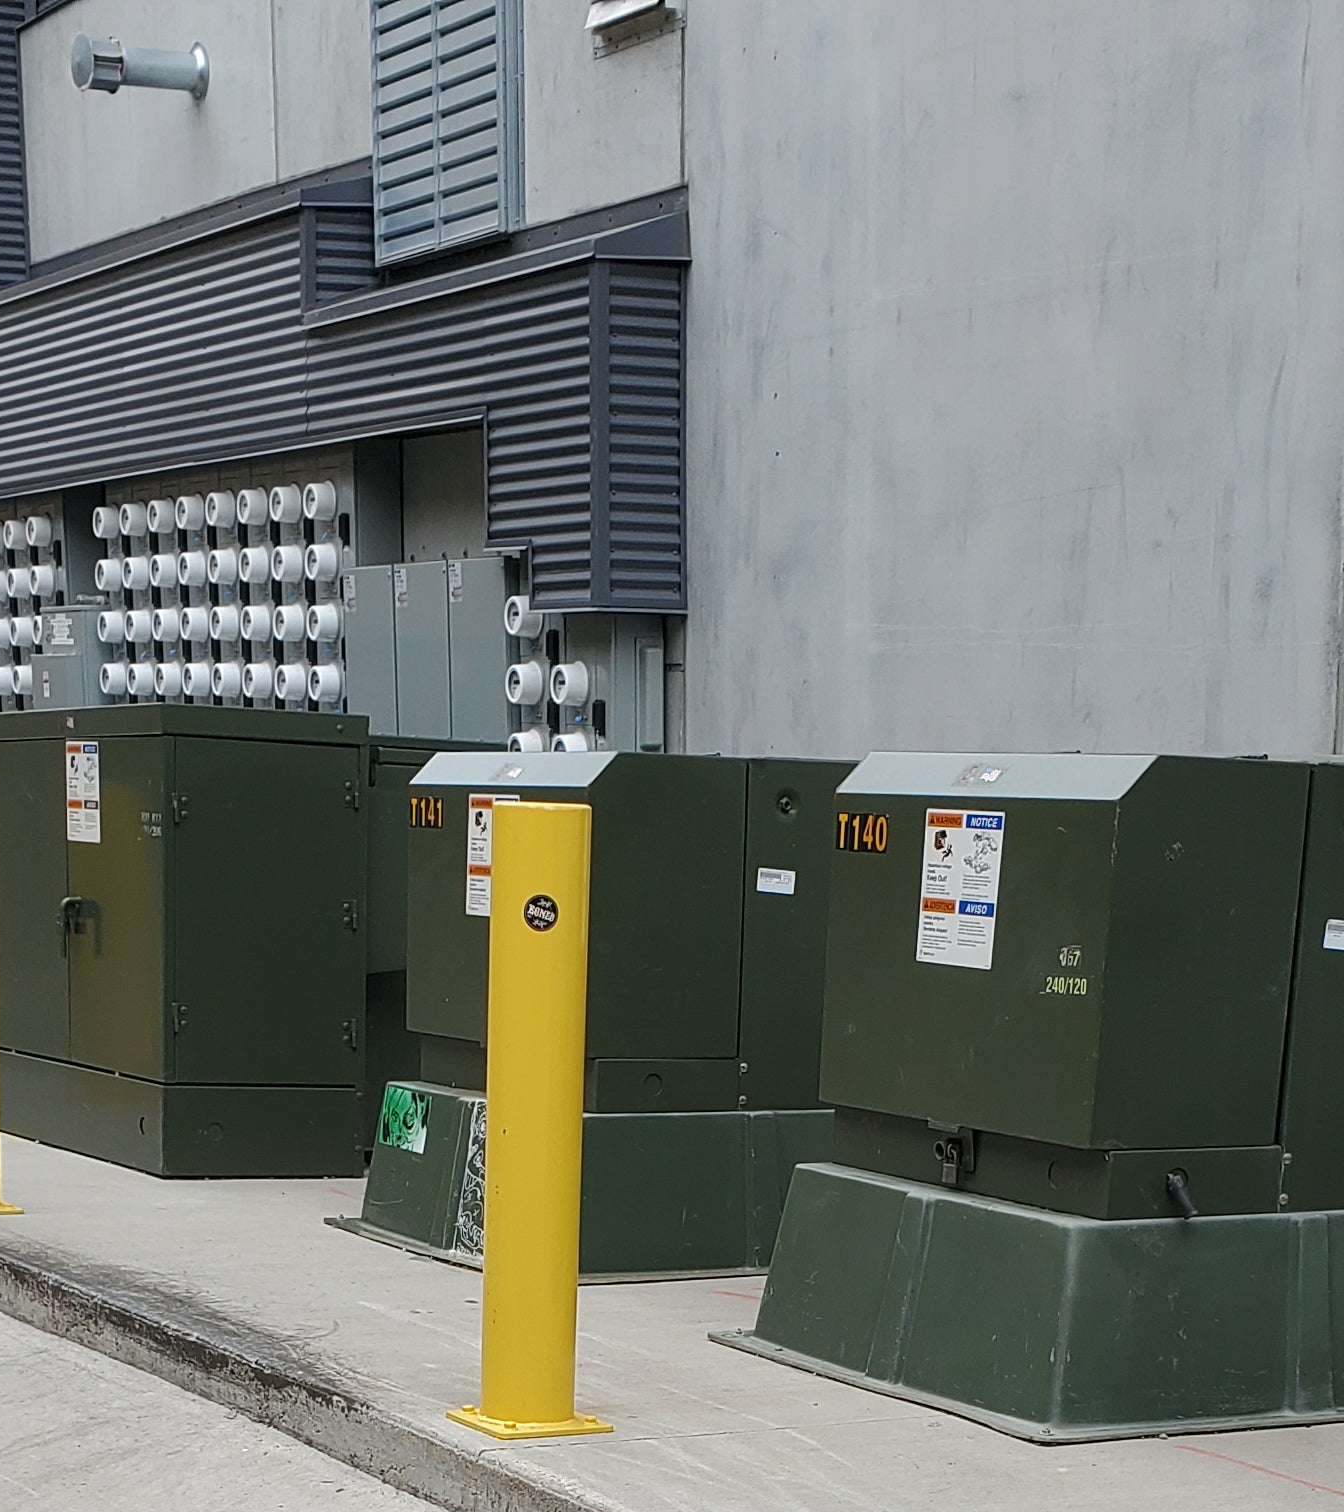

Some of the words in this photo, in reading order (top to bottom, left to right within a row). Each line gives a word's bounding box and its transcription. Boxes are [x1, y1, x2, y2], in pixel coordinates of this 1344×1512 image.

[411, 797, 442, 828] T141
[970, 816, 998, 828] NOTICE
[839, 813, 887, 851] T140
[965, 903, 987, 915] AVISO
[1046, 976, 1087, 995] 240/120
